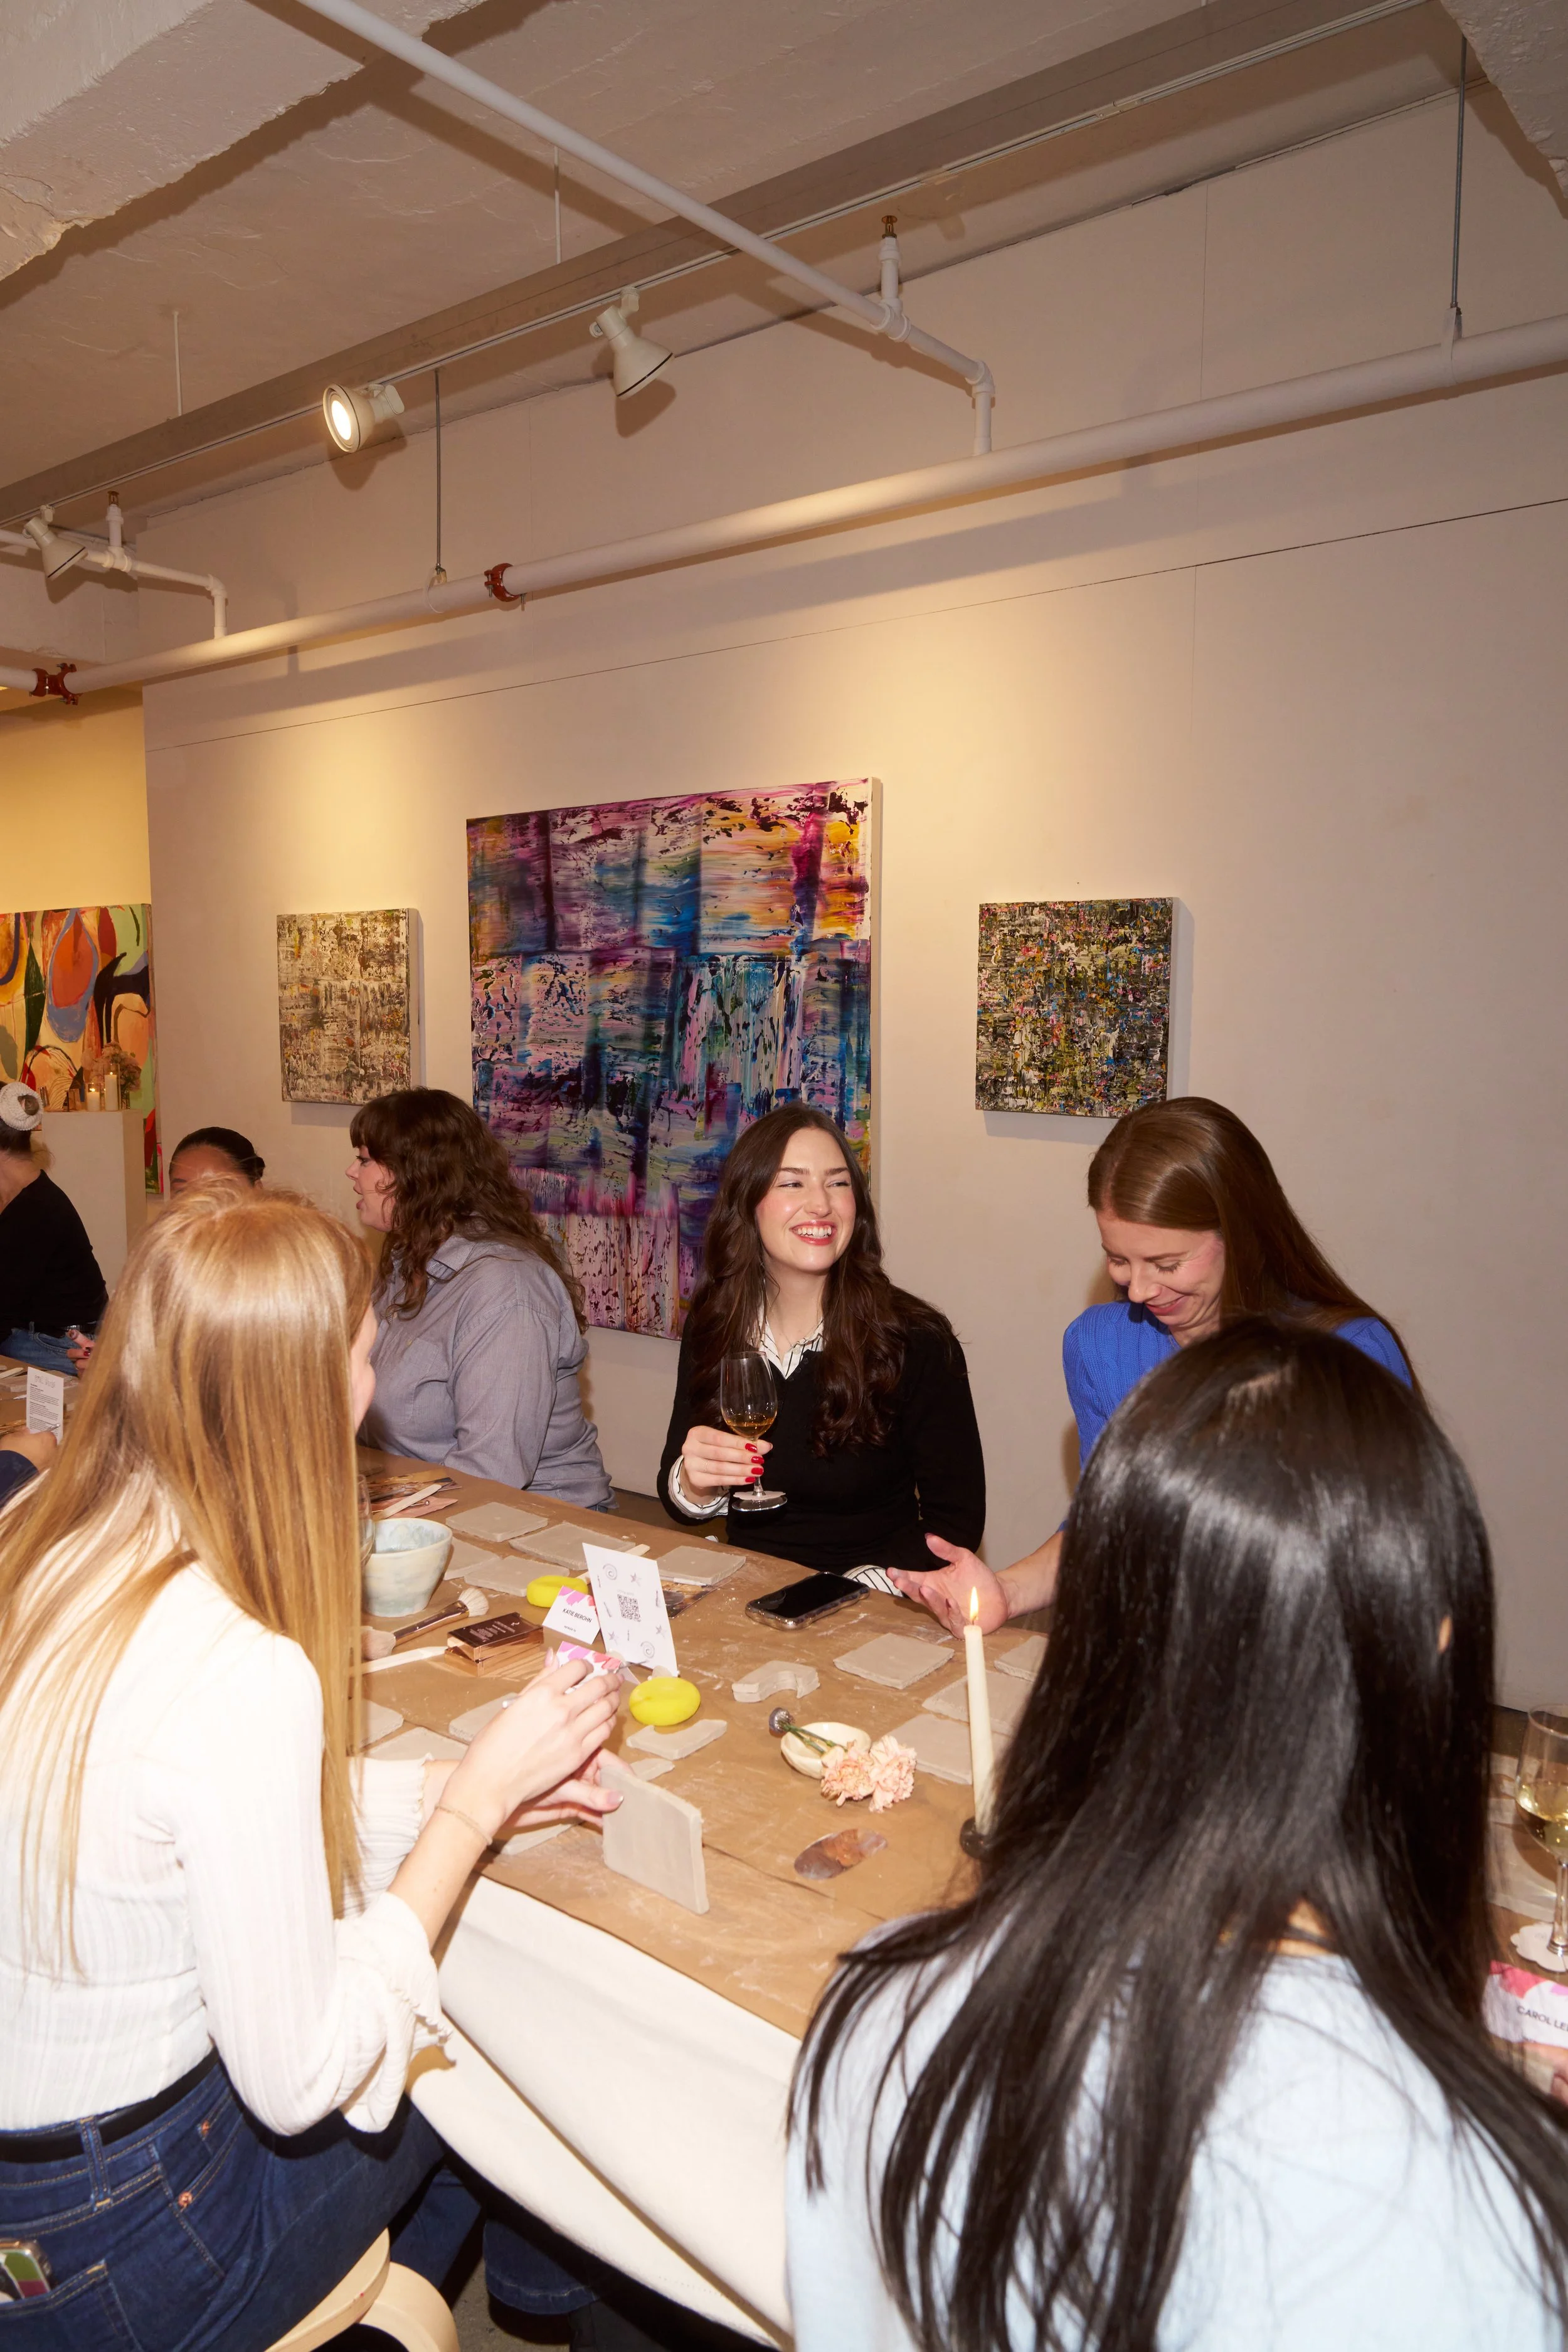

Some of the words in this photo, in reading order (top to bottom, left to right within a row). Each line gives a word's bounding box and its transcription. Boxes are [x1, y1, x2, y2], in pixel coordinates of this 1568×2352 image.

[563, 1608, 575, 1617] KATIE
[574, 1612, 592, 1623] BEROHN
[1517, 2005, 1551, 2025] CAROL
[1554, 2019, 1568, 2032] LE
